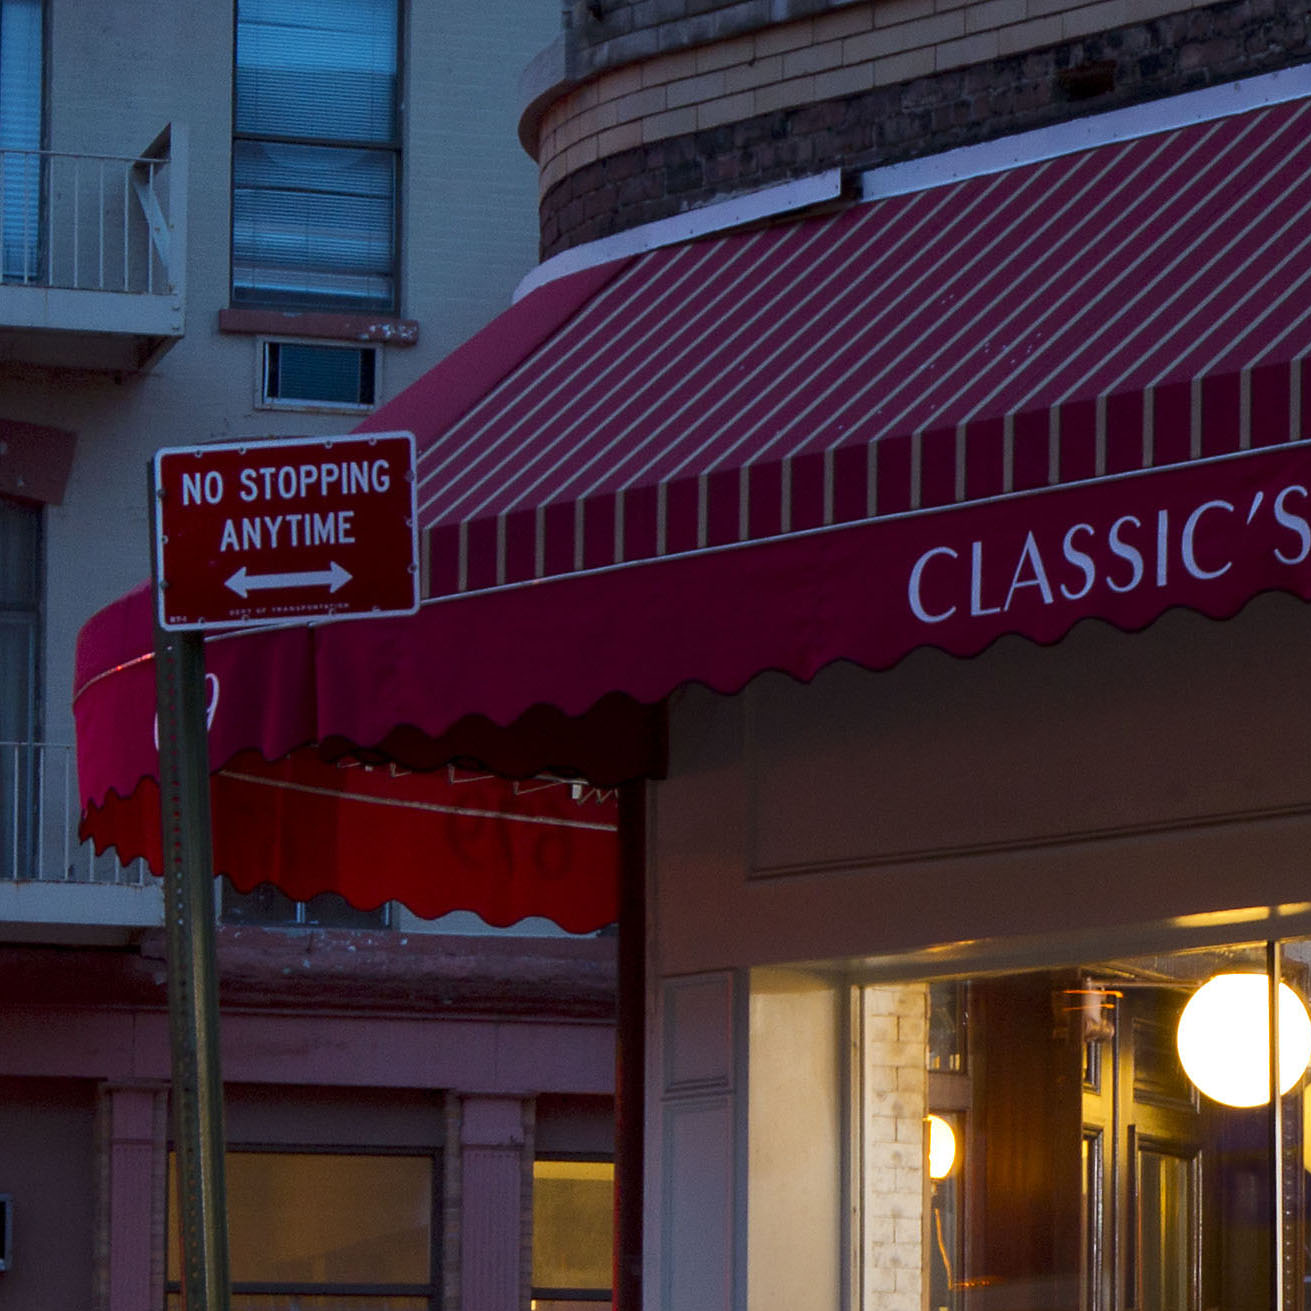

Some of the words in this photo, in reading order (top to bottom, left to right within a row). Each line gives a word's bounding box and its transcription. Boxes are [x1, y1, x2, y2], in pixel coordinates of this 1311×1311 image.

[181, 471, 225, 507] NO
[239, 460, 391, 503] STOPPING
[219, 511, 356, 553] ANYTIME
